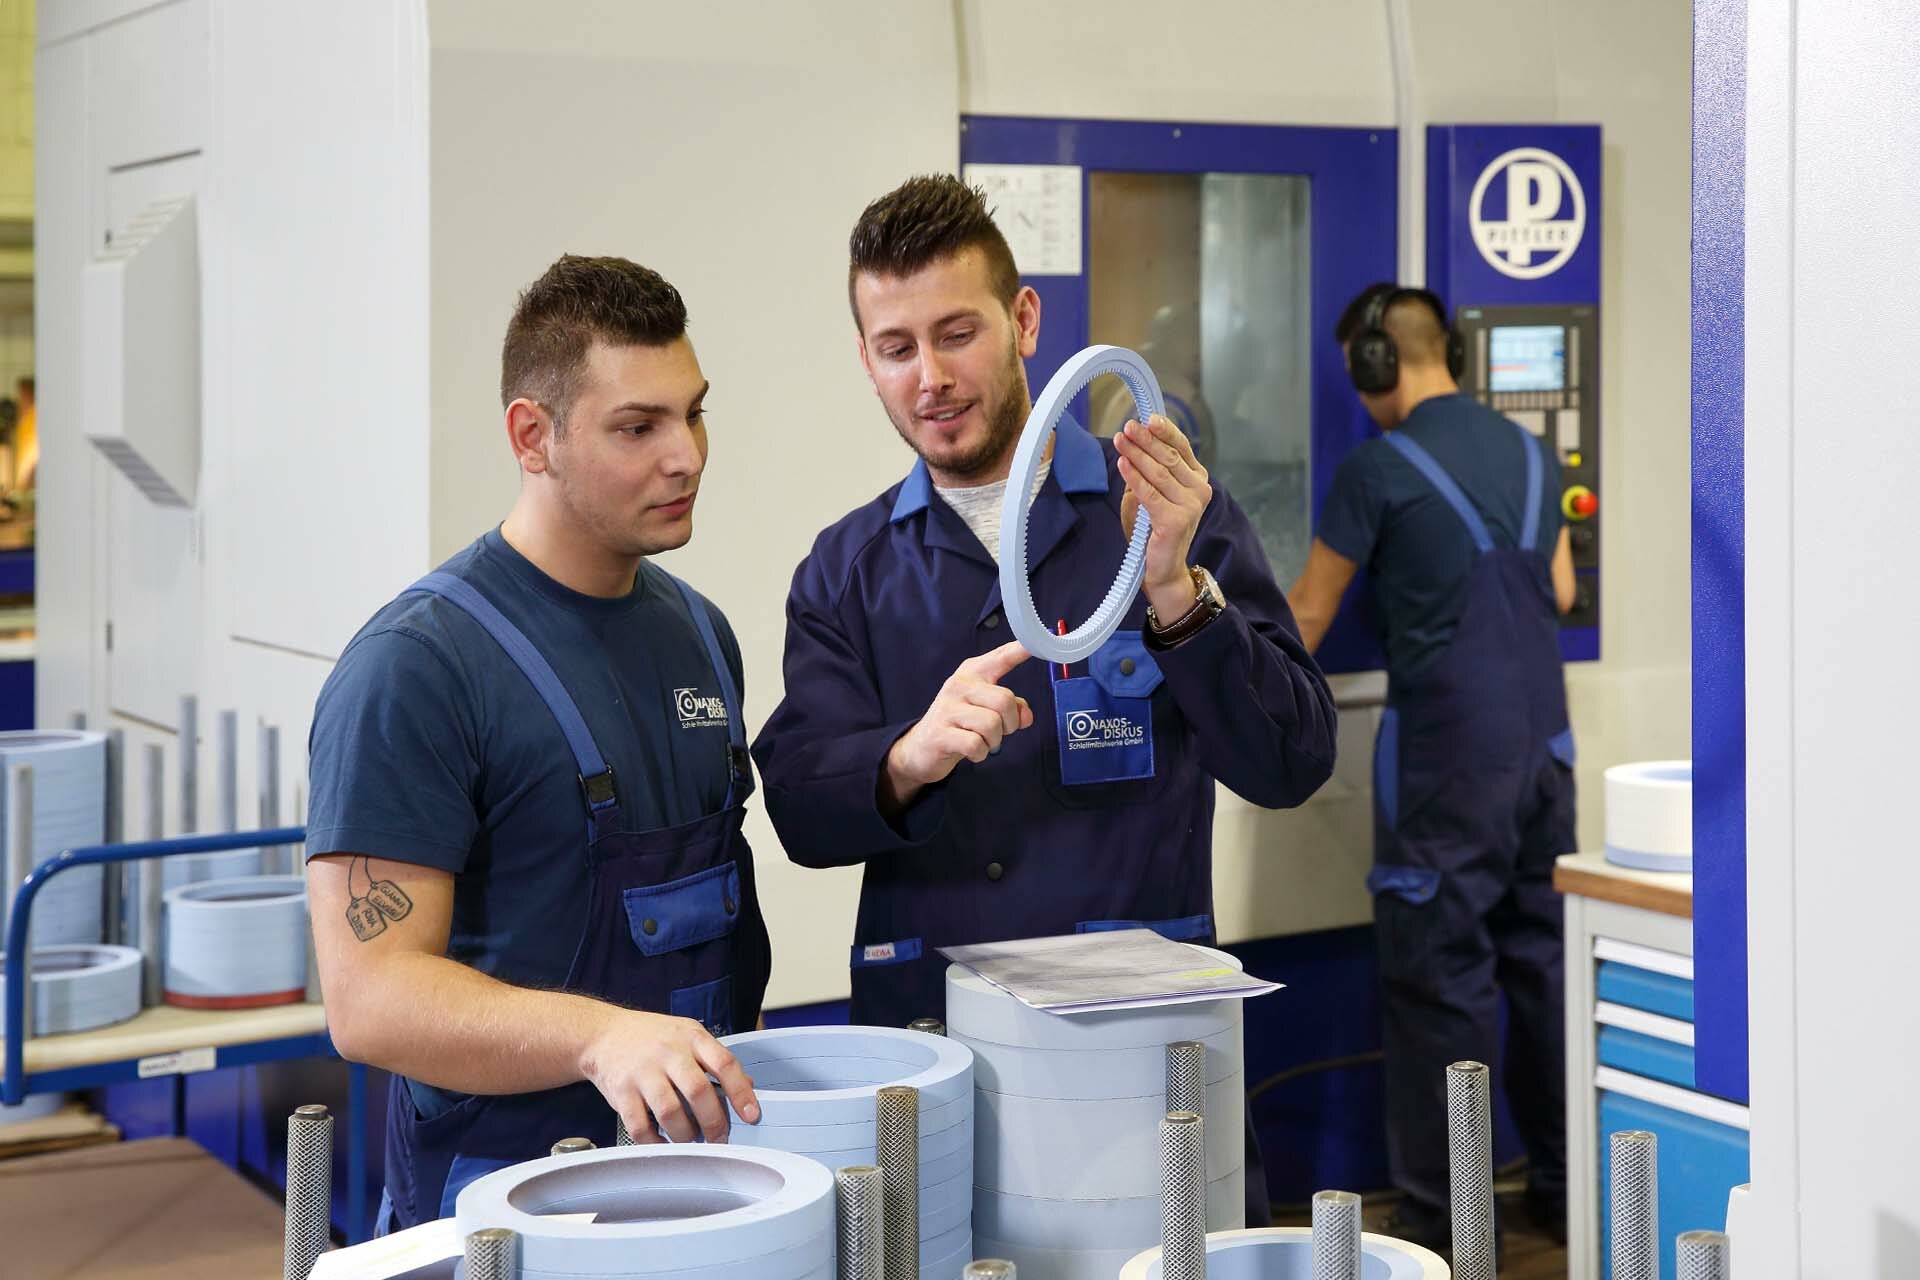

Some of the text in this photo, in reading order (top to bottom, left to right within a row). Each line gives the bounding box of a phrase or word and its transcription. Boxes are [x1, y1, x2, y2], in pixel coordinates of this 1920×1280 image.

[1091, 717, 1132, 730] NAXOS-
[1104, 726, 1144, 739] DISKUS
[1124, 737, 1144, 746] GmbH
